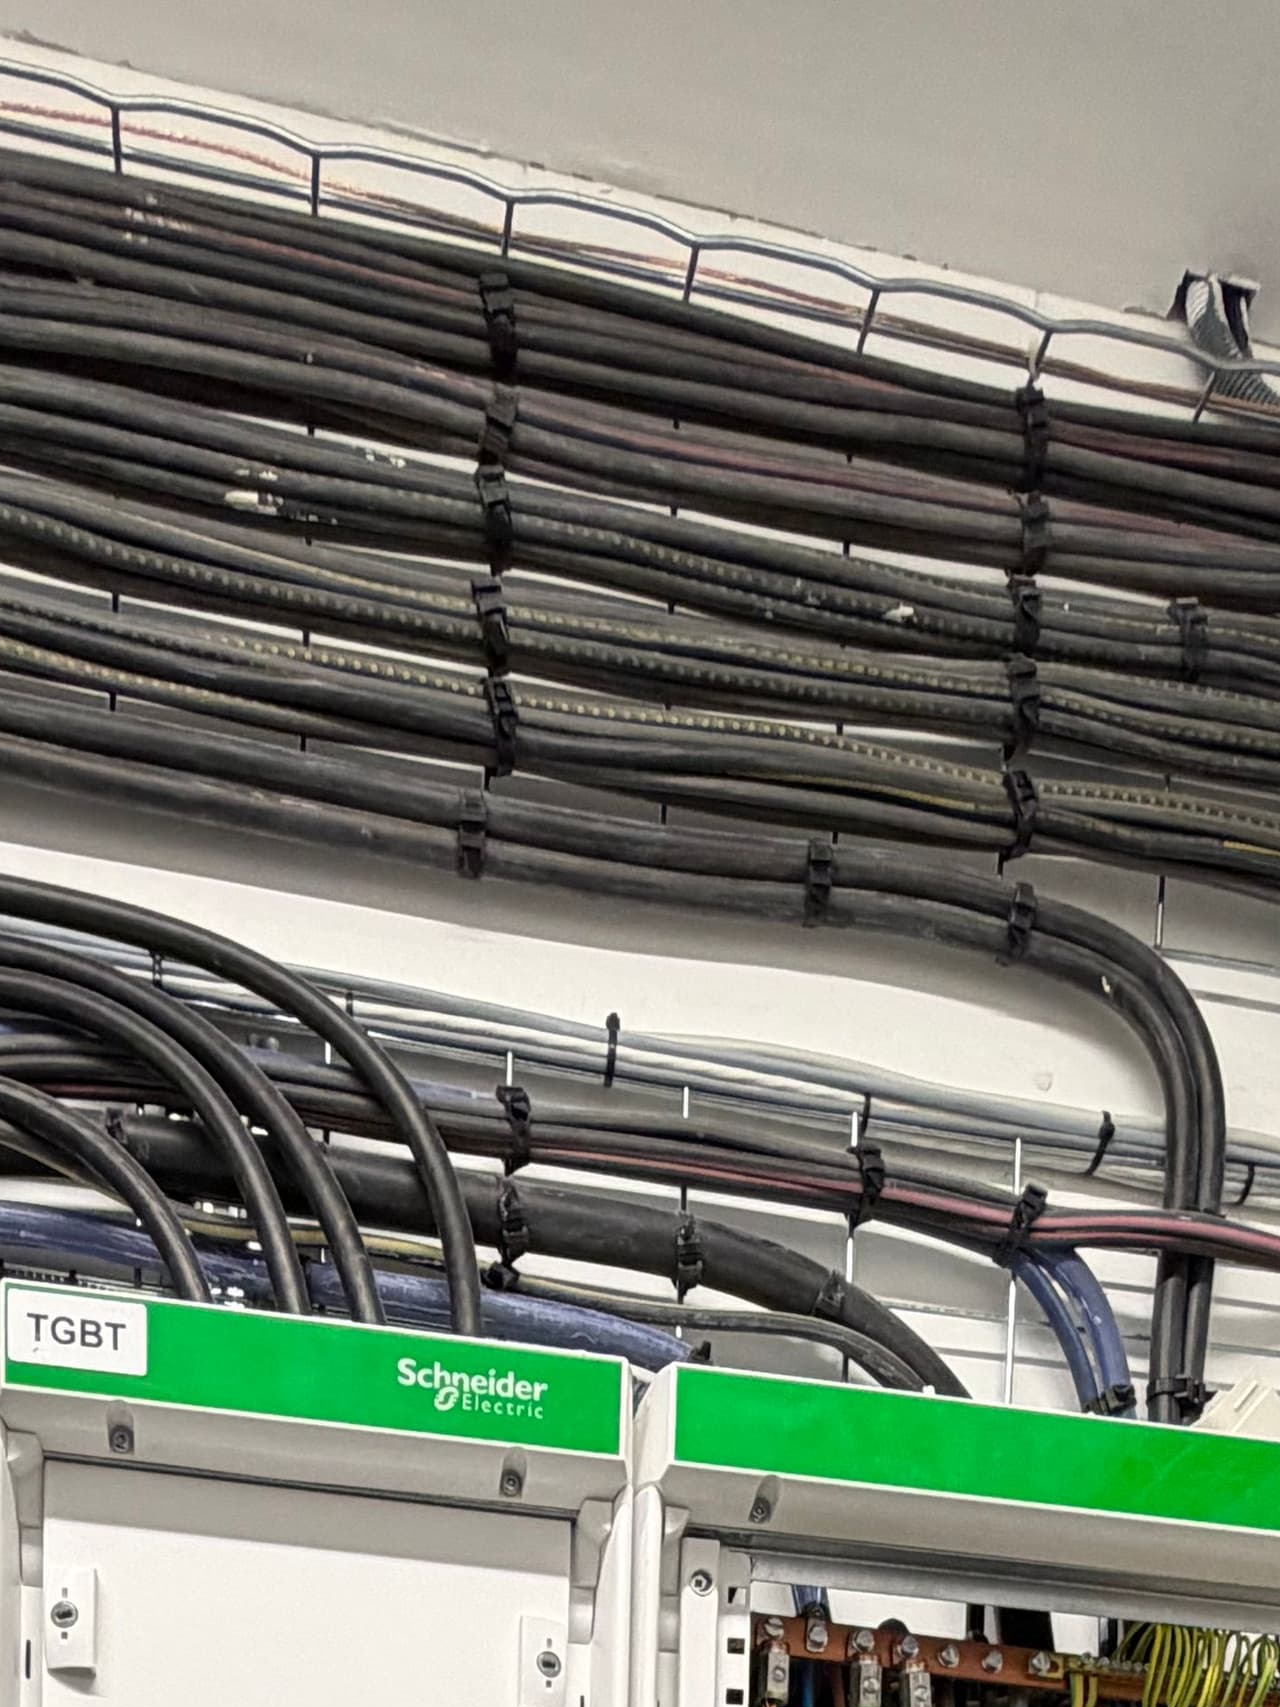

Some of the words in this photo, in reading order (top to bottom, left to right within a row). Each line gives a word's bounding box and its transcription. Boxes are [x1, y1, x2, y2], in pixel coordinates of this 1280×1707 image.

[27, 1312, 127, 1351] TGBT
[397, 1357, 549, 1402] Schneider
[462, 1393, 544, 1420] Electric
